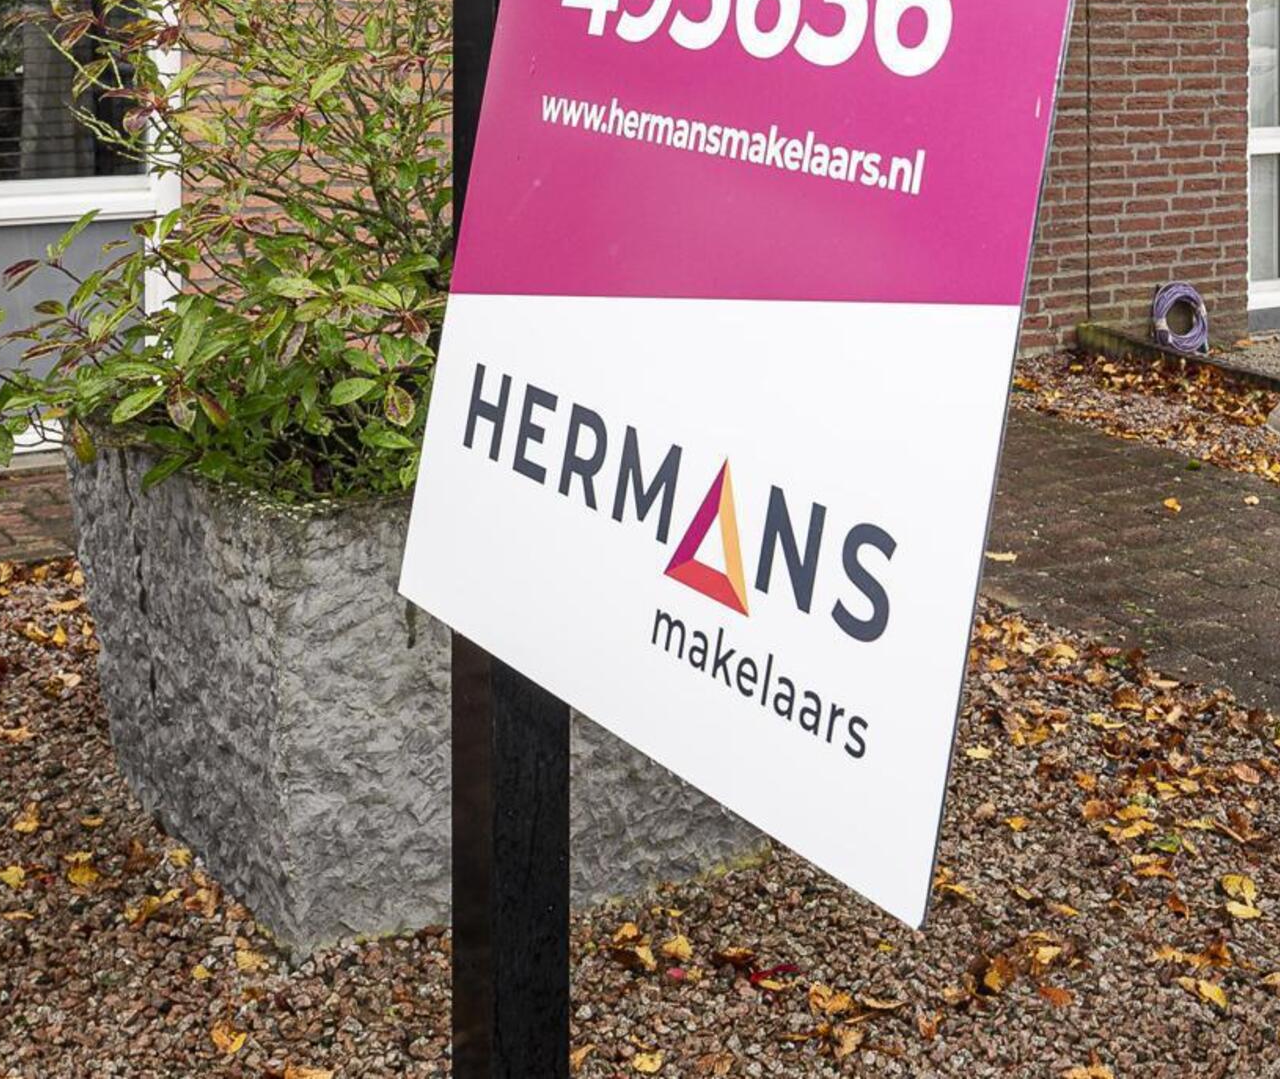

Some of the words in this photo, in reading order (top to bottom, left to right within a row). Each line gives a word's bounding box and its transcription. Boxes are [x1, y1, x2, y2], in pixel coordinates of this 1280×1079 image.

[542, 95, 926, 195] www.hermansmakelaars.nl
[463, 363, 898, 643] HERMANS
[651, 608, 869, 759] makelaars
